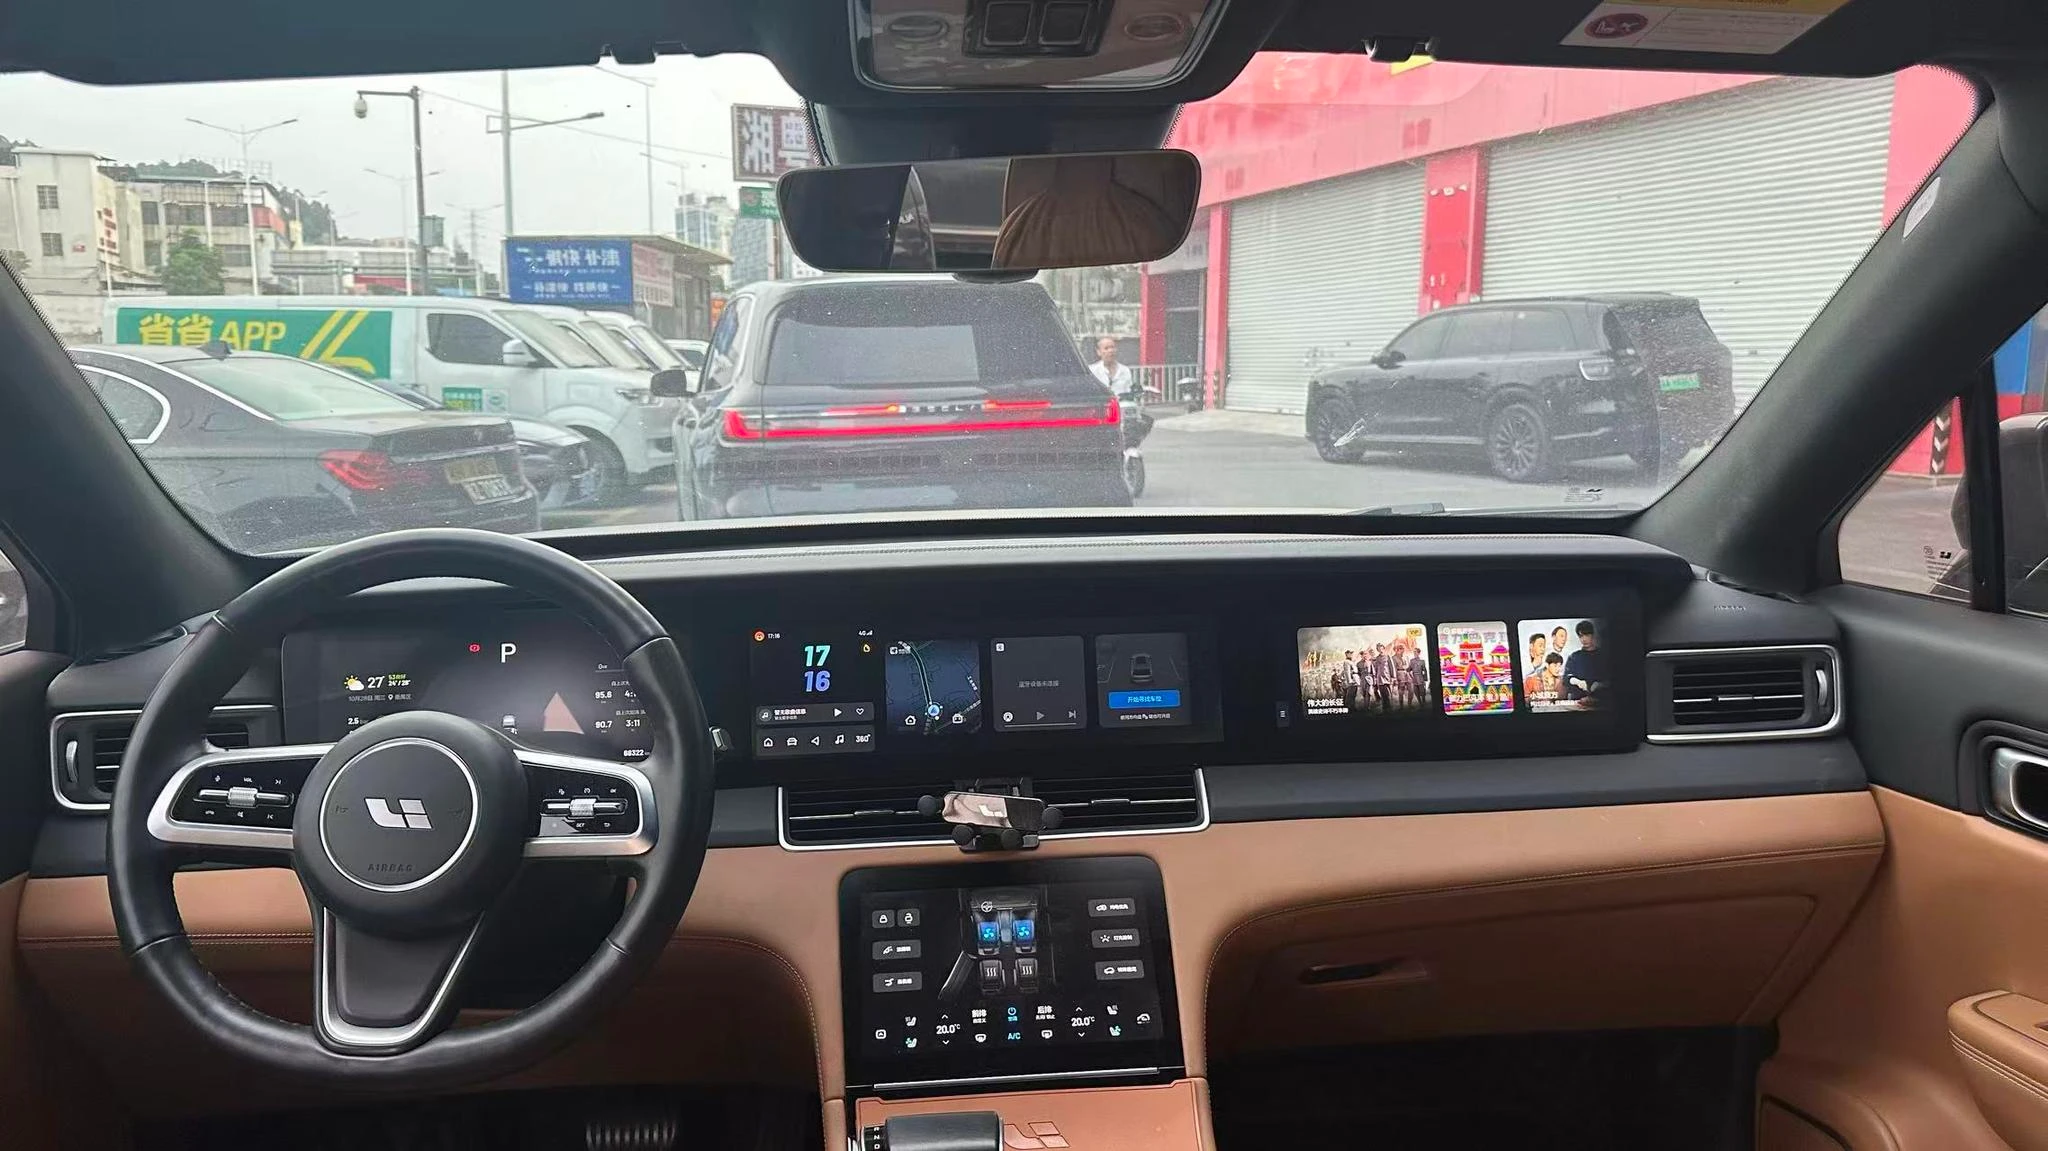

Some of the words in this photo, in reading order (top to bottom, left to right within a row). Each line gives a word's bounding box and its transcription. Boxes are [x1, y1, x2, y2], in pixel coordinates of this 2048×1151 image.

[219, 320, 287, 351] APP
[500, 643, 517, 663] P
[804, 645, 831, 667] 17
[804, 670, 831, 692] 16
[1307, 698, 1345, 708] 伟大的长征
[367, 863, 414, 873] AIRBAG
[1007, 1032, 1021, 1040] A/C
